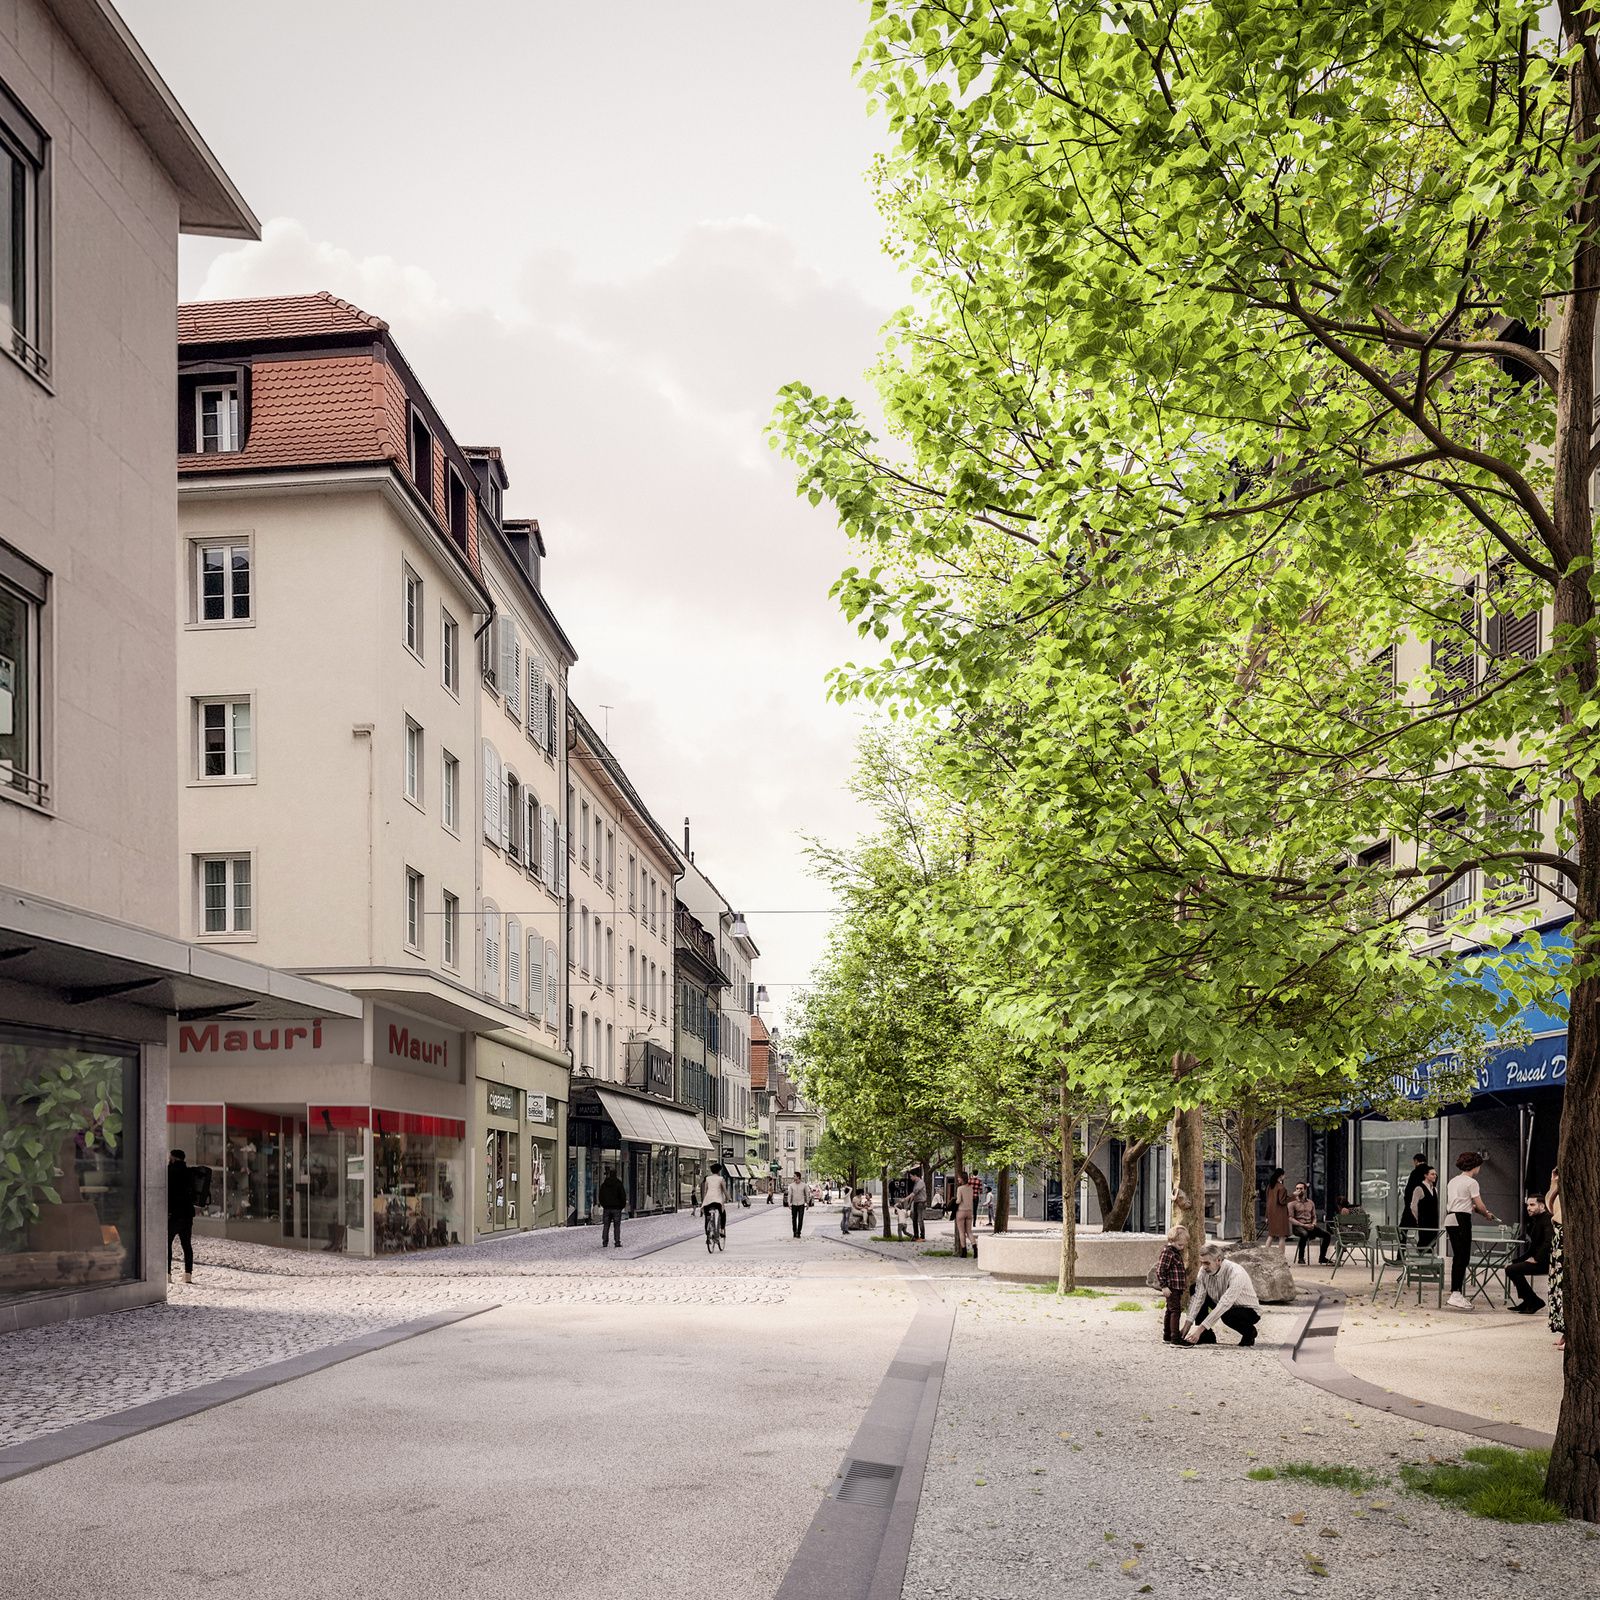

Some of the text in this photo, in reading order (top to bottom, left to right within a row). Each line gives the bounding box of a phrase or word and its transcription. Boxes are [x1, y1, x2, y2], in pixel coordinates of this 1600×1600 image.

[179, 1018, 323, 1053] Mauri
[388, 1023, 448, 1068] Mauri
[1506, 1060, 1547, 1086] Pascal
